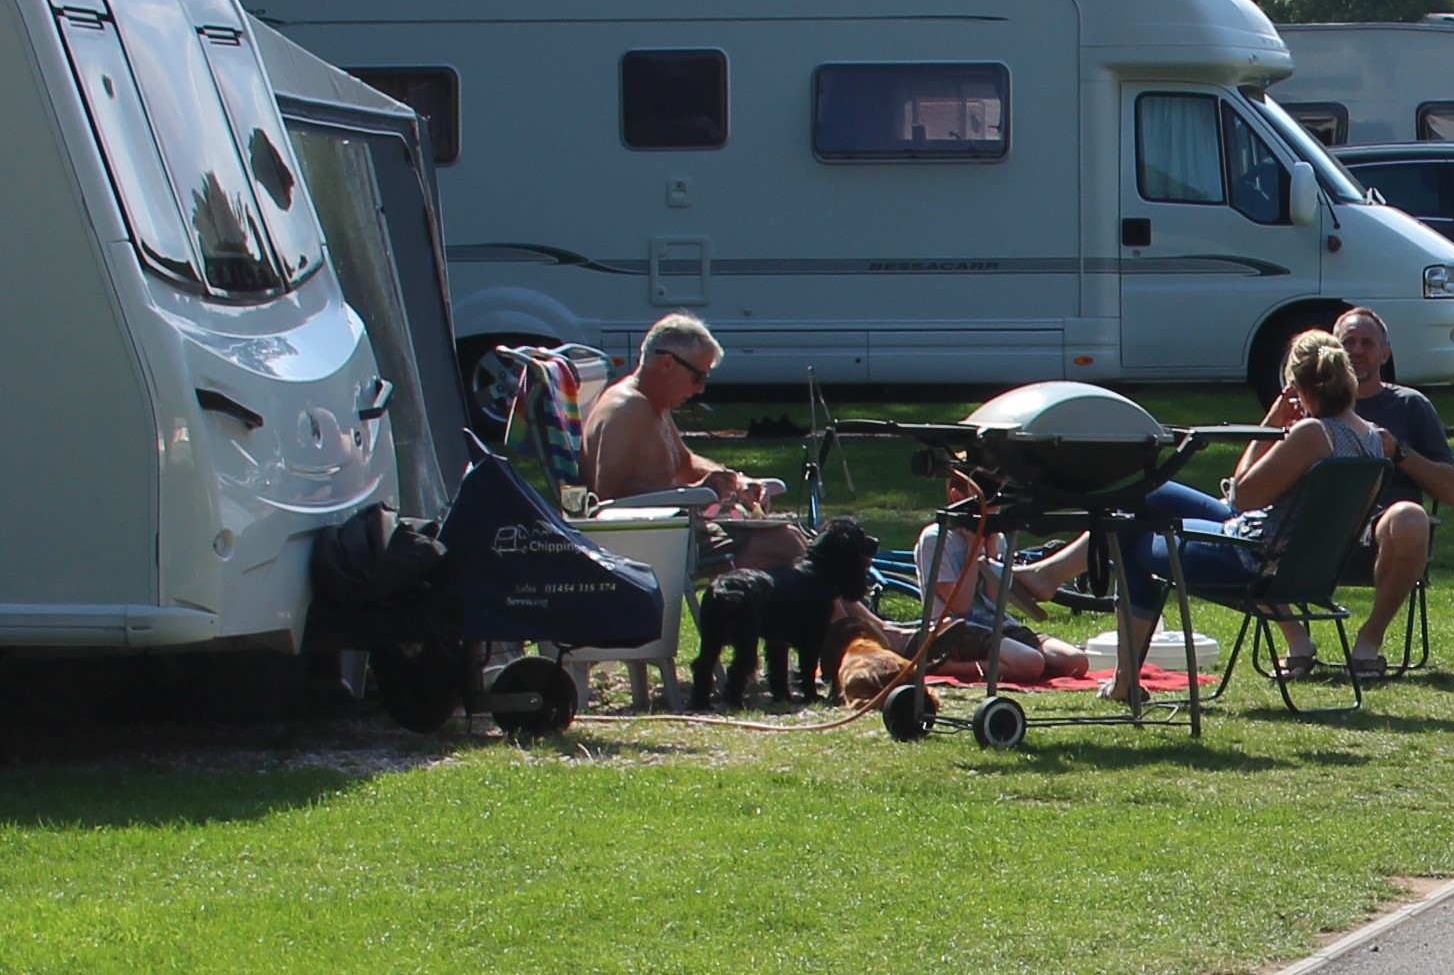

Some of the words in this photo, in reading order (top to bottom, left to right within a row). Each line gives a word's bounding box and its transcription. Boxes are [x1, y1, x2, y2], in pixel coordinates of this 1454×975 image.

[528, 540, 583, 554] Chipping
[544, 583, 576, 593] 01454
[505, 596, 549, 608] Servicing
